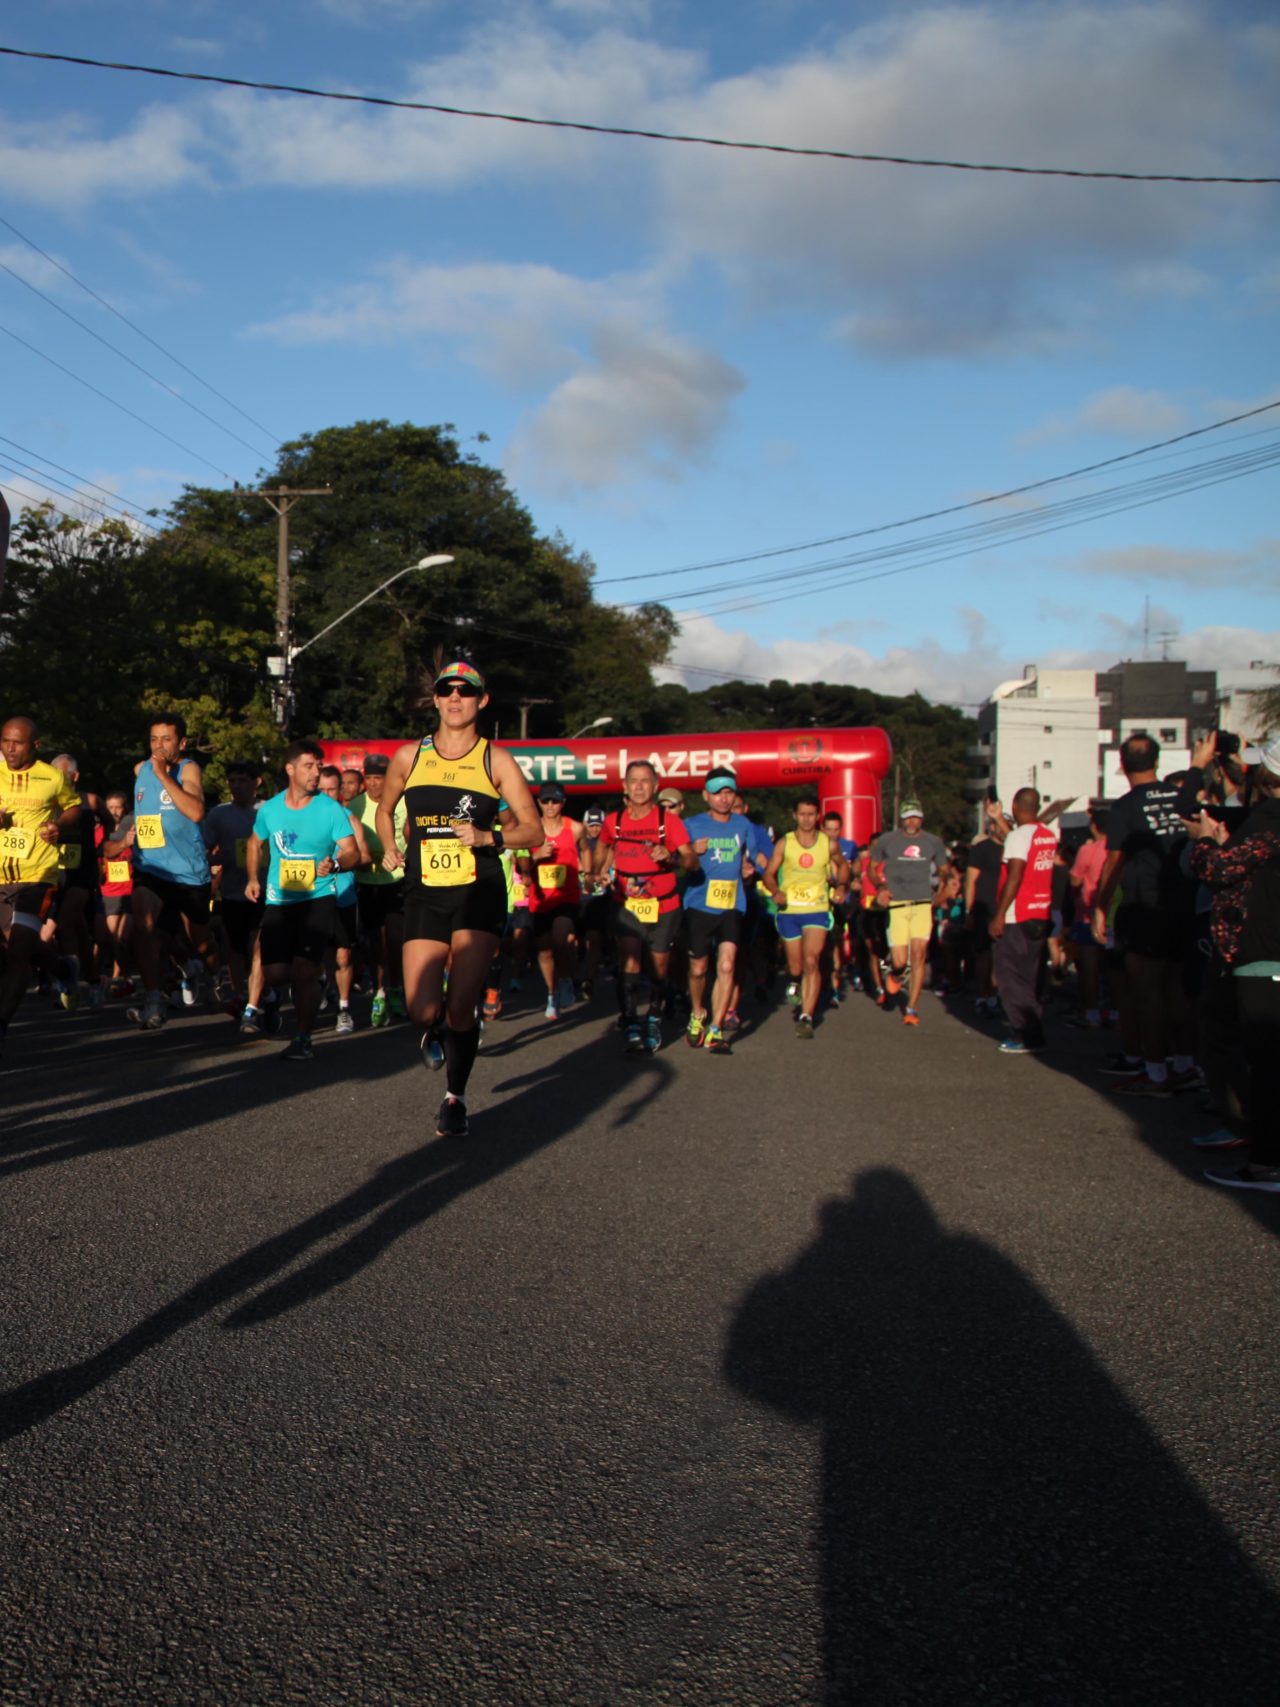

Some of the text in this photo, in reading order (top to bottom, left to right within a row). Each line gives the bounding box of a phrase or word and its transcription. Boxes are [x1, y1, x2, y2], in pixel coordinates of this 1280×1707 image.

[513, 748, 737, 781] RTE E LAZER
[781, 765, 832, 775] CURITIBA
[138, 825, 155, 836] 676
[3, 836, 26, 850] 288
[429, 853, 462, 870] 601
[284, 869, 307, 881] 119
[712, 888, 733, 899] 086
[631, 904, 652, 915] 100
